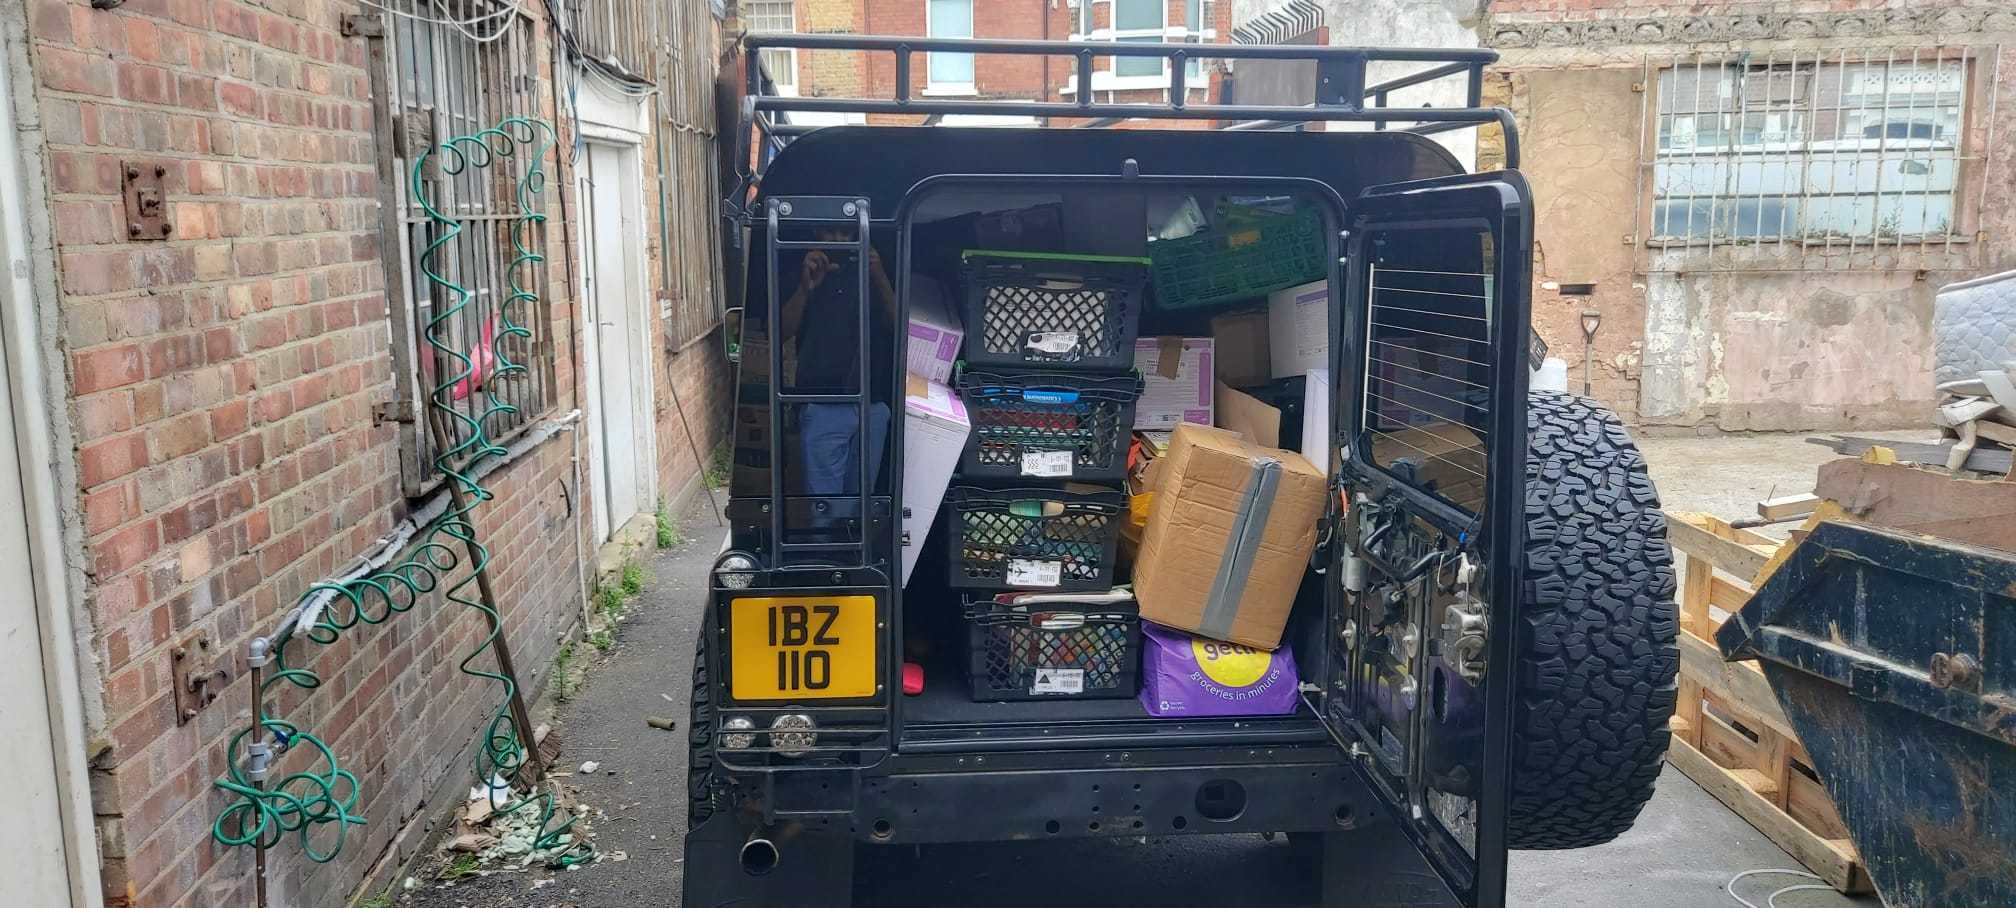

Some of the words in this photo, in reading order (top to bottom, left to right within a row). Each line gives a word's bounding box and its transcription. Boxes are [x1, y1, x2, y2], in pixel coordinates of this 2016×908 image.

[768, 605, 840, 646] IBZ
[778, 650, 831, 690] 110
[1190, 671, 1234, 701] groceries
[1236, 691, 1246, 701] in
[1247, 667, 1280, 698] minutes
